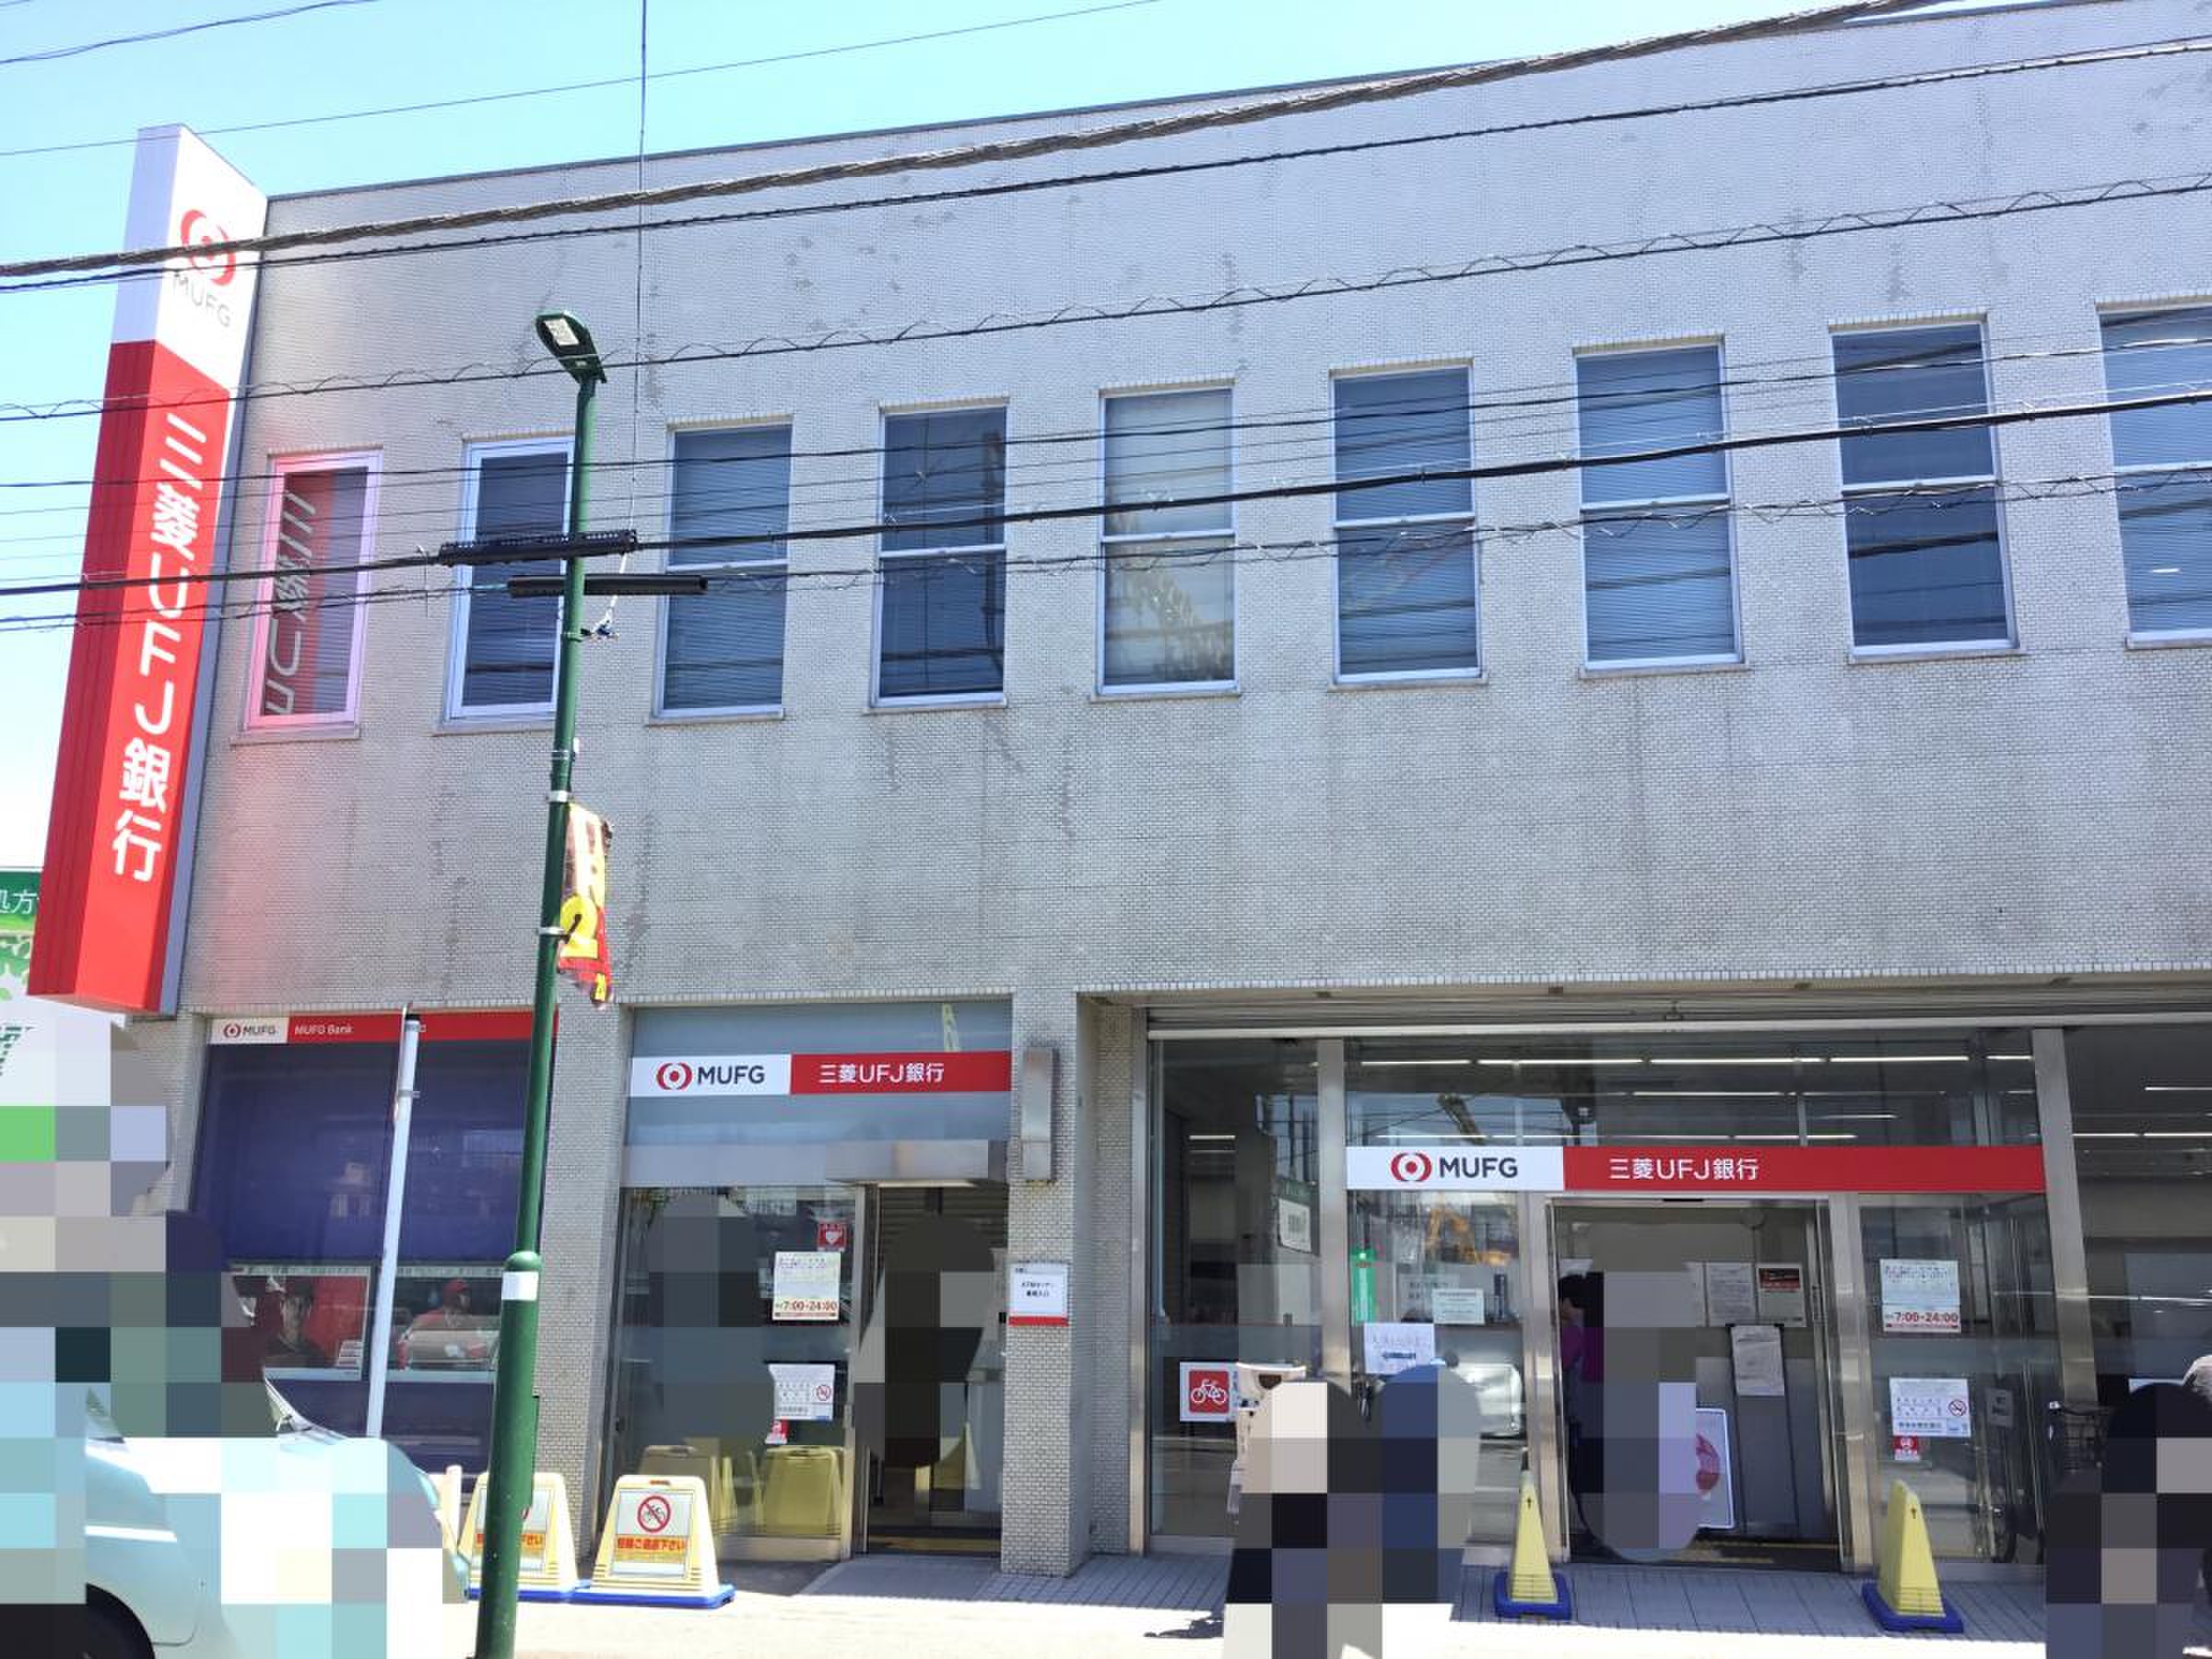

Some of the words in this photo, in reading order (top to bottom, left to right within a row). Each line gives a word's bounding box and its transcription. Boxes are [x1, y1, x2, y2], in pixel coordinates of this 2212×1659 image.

[172, 274, 231, 328] MUFG
[112, 412, 207, 883] 三菱UFJ銀行
[242, 1024, 276, 1035] MUFG
[294, 1025, 326, 1035] MUFG
[327, 1024, 353, 1034] Bank
[697, 1065, 766, 1085] MUFG
[818, 1063, 945, 1084] 三菱UFJ銀行
[1439, 1158, 1519, 1178] MUFG
[1608, 1158, 1759, 1181] 三菱UFJ銀行
